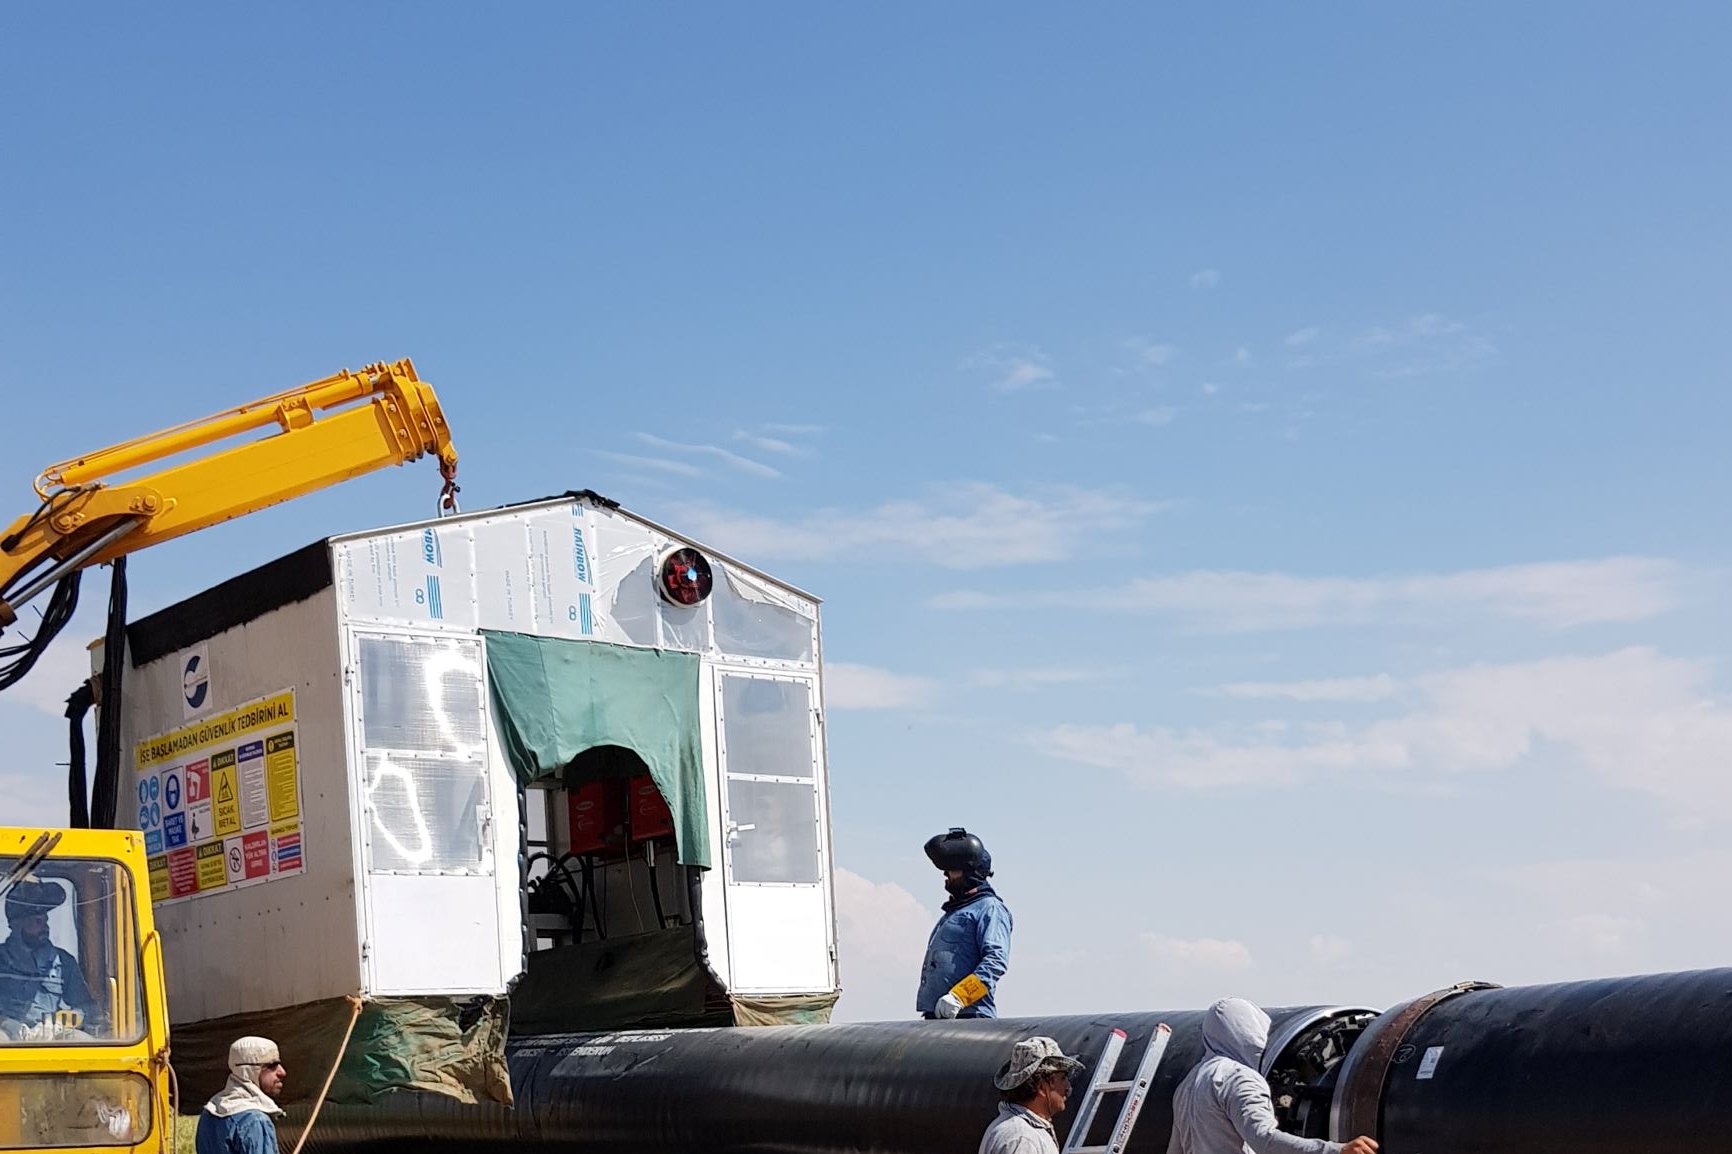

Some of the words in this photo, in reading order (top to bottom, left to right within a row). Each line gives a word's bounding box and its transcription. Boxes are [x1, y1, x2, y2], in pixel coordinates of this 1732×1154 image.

[574, 527, 586, 582] RAINBOW
[199, 719, 237, 744] GÜVENLİK
[237, 705, 277, 731] TEDBİRİNİ
[277, 701, 289, 718] AL
